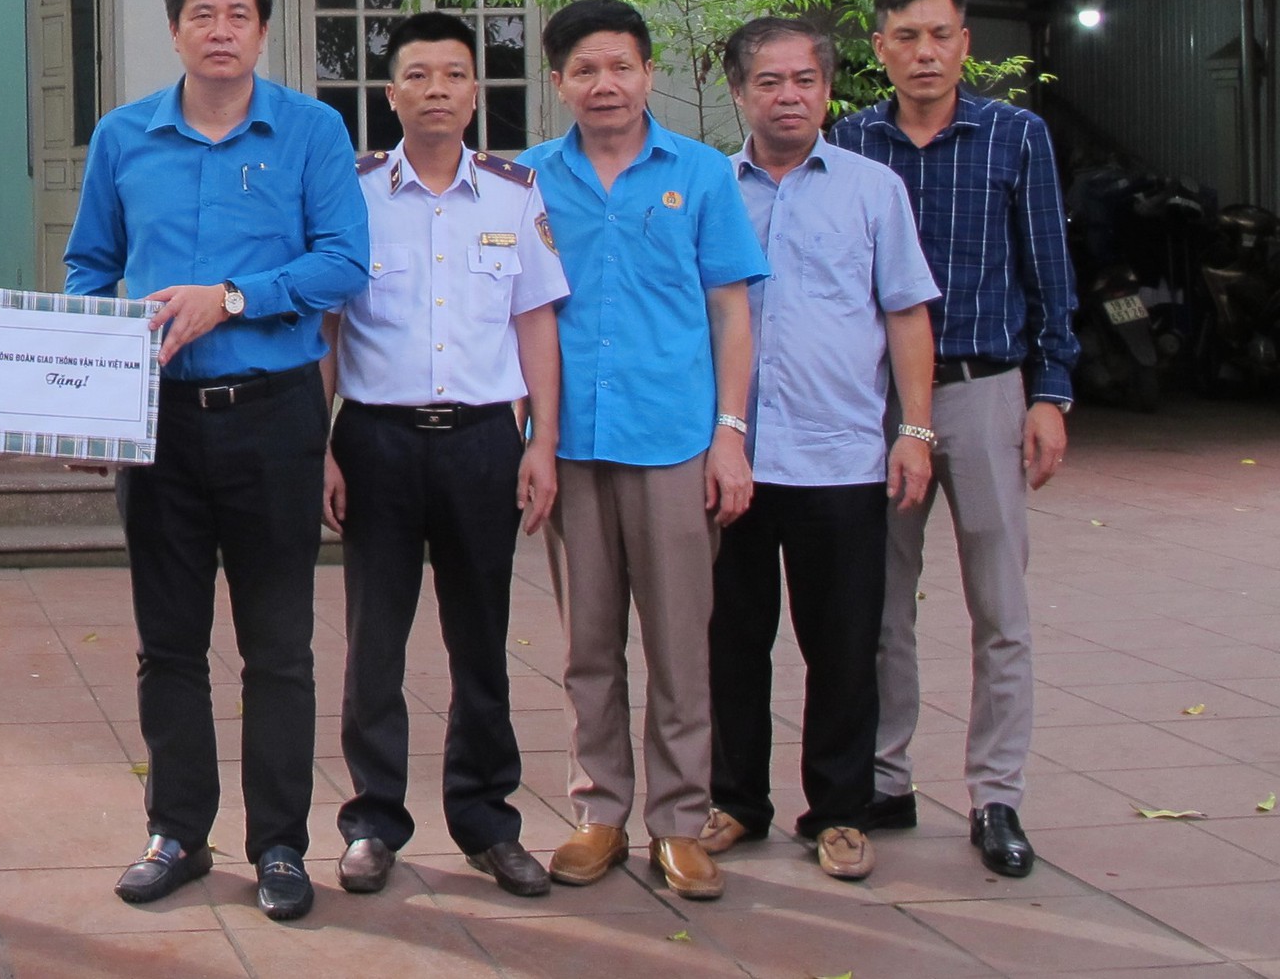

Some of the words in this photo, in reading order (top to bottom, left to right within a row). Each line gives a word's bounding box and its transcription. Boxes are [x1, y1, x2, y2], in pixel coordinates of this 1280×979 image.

[36, 355, 54, 364] GIAO
[55, 354, 78, 366] THÔNG
[108, 358, 123, 370] VIỆT
[124, 361, 140, 370] NAM
[45, 372, 90, 389] Tặng!
